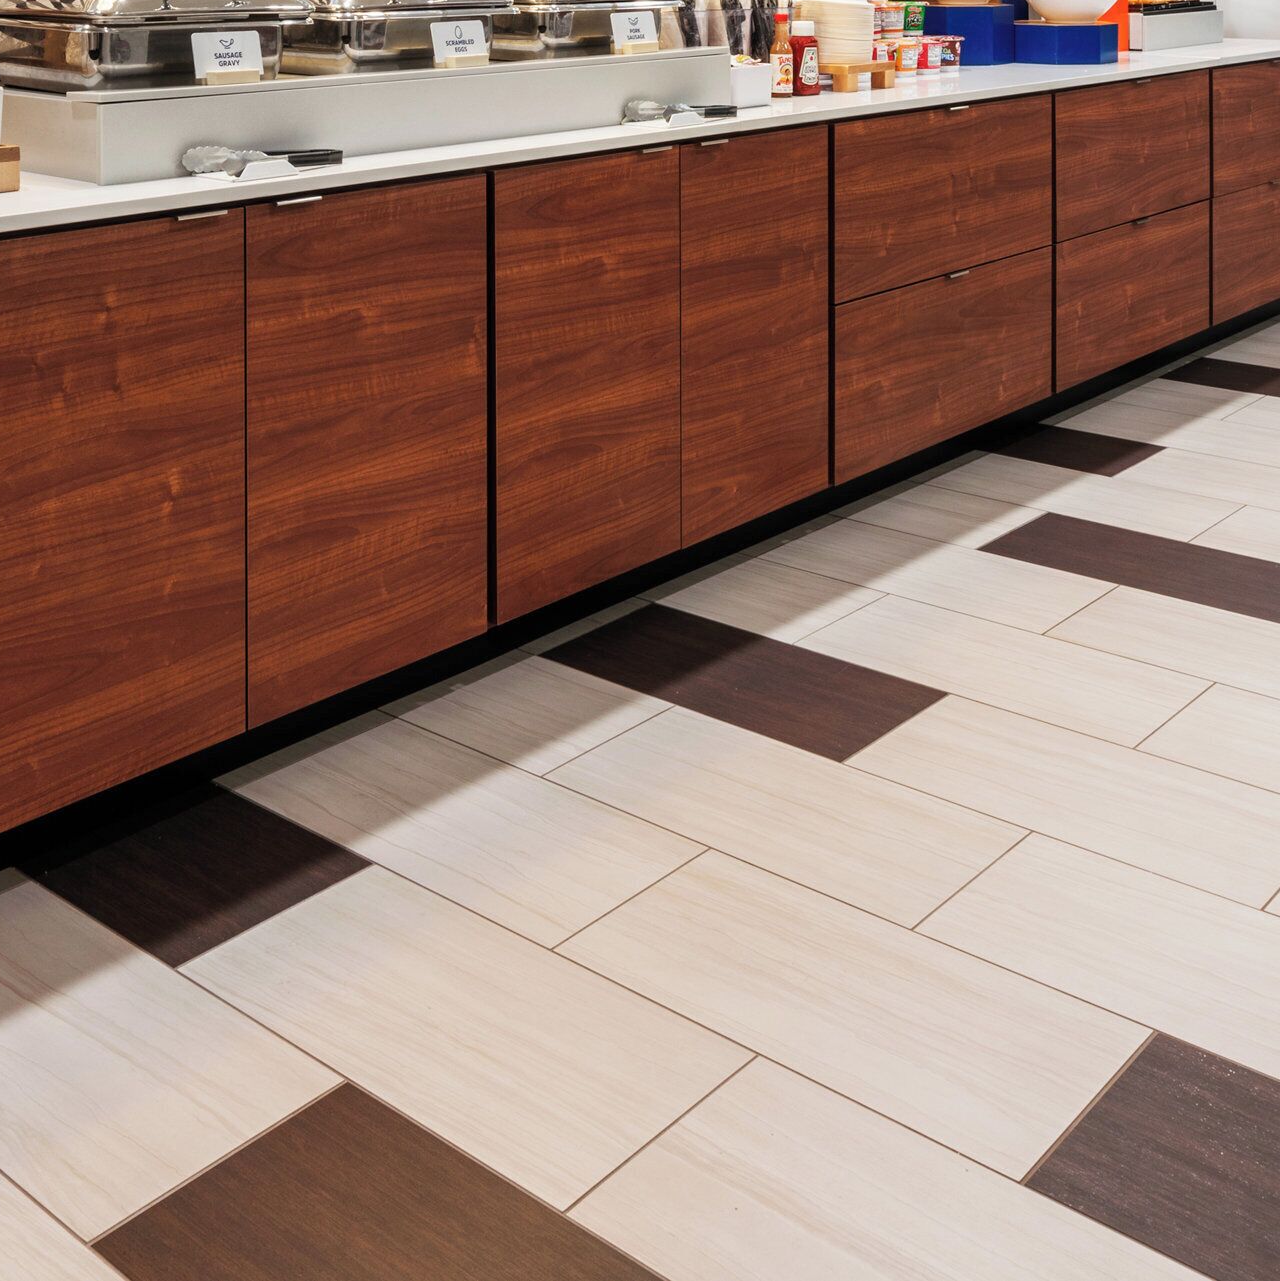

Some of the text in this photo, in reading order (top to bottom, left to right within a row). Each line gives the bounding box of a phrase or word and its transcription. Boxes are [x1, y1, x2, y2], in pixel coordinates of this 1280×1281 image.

[445, 38, 475, 47] SCRAMBLED
[214, 51, 243, 60] SAUSAGE
[218, 59, 240, 67] GRAVY
